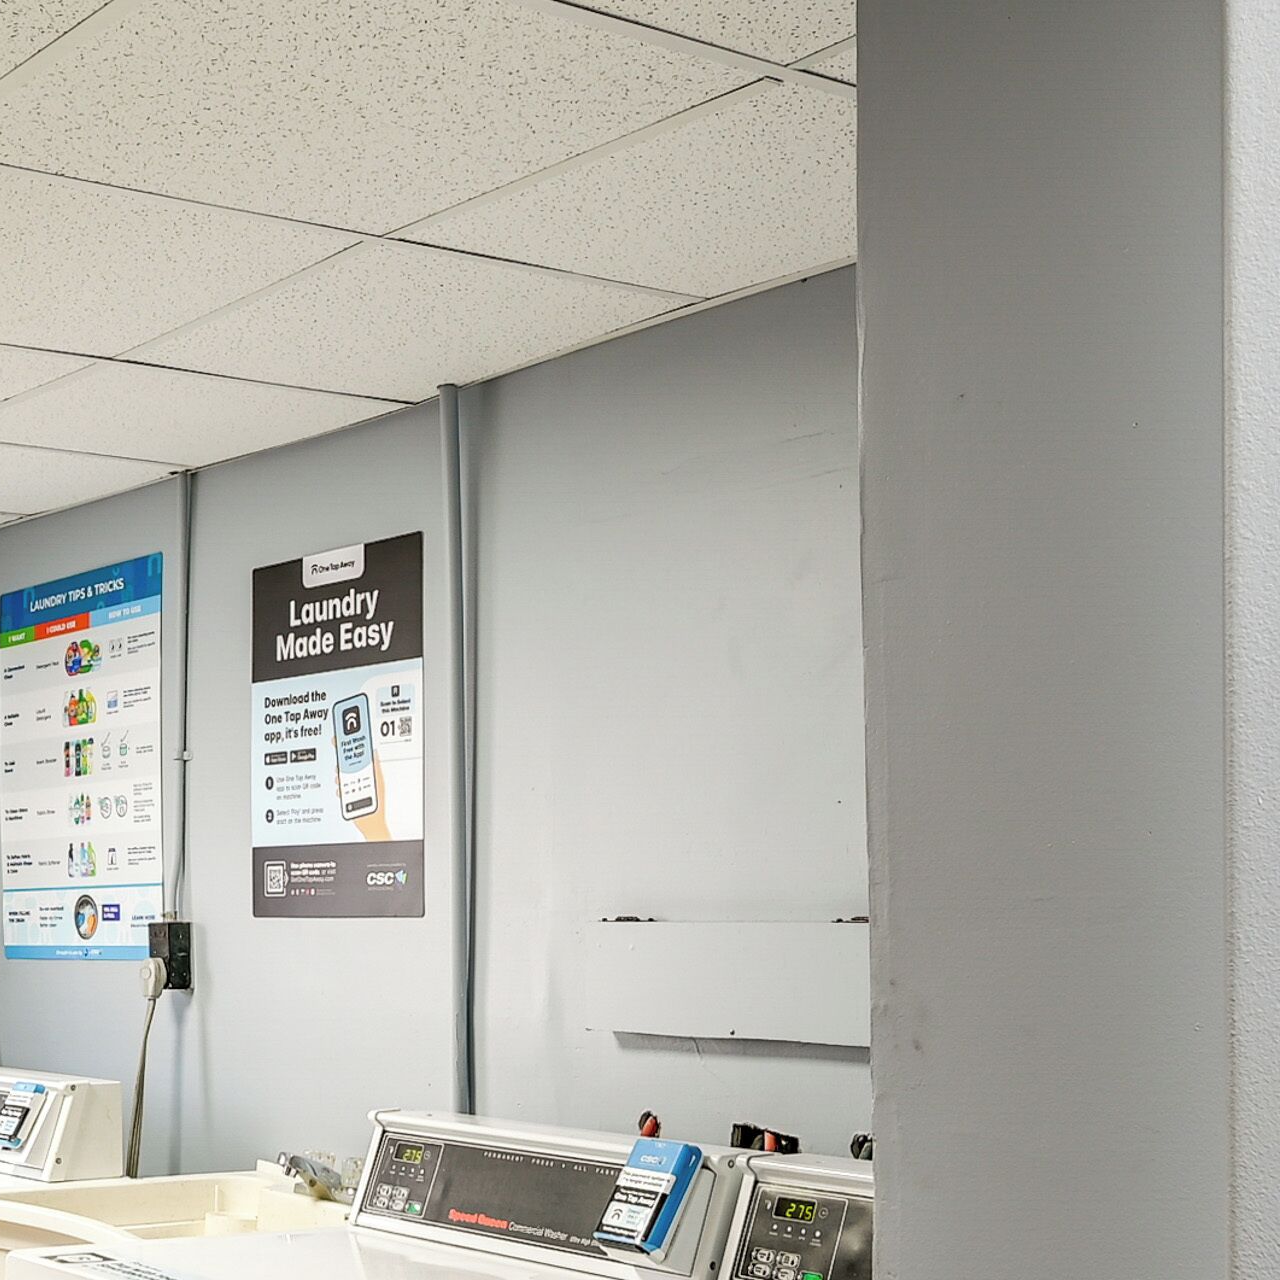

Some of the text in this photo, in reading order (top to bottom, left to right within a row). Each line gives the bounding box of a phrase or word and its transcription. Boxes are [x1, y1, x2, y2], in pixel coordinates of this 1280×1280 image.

[30, 578, 124, 612] LAUNDRY TIPS & TRICKS
[290, 588, 379, 627] Laundry
[276, 621, 394, 662] Made Easy
[264, 690, 326, 708] Download the
[264, 708, 329, 725] One Tap Away
[264, 724, 322, 744] app, it's free!
[380, 720, 395, 737] 01
[403, 1149, 423, 1164] 275
[484, 1152, 524, 1162] PERMANENT
[532, 1158, 554, 1167] PRESS
[574, 1164, 588, 1172] ALL
[785, 1203, 813, 1220] 275
[448, 1209, 478, 1224] Speed
[544, 1228, 568, 1241] Washer
